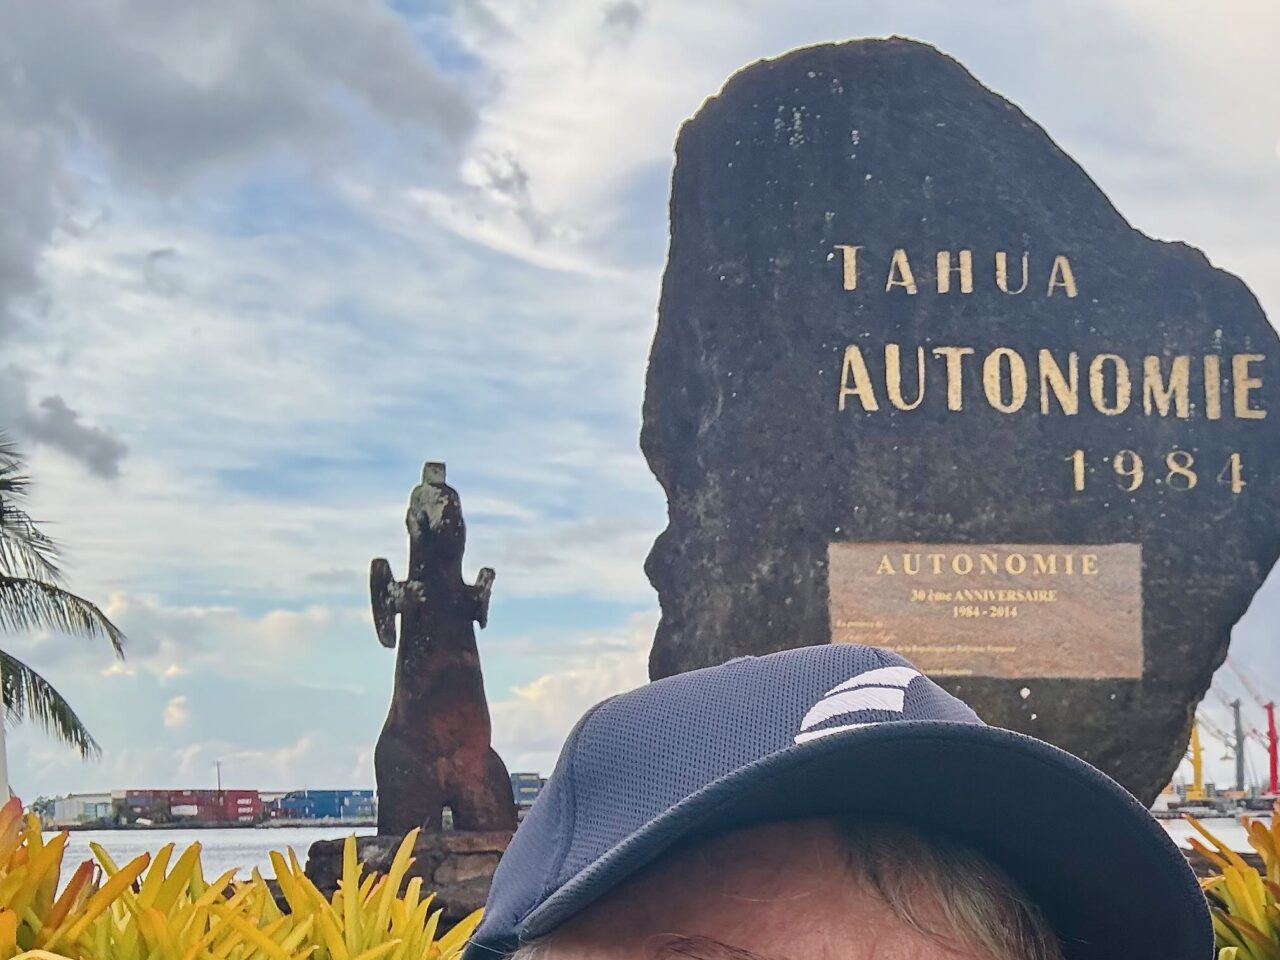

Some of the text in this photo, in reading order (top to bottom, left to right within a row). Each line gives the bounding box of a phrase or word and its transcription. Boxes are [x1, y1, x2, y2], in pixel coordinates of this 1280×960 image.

[834, 245, 1078, 298] TAHUA
[838, 344, 1267, 420] AUTONOMIE
[1065, 449, 1247, 494] 1984
[876, 553, 1099, 575] AUTONOMIE
[911, 590, 926, 602] 30
[954, 590, 1058, 602] ANNIVERSAIRE
[953, 606, 980, 618] 1984
[990, 606, 1018, 618] 2014
